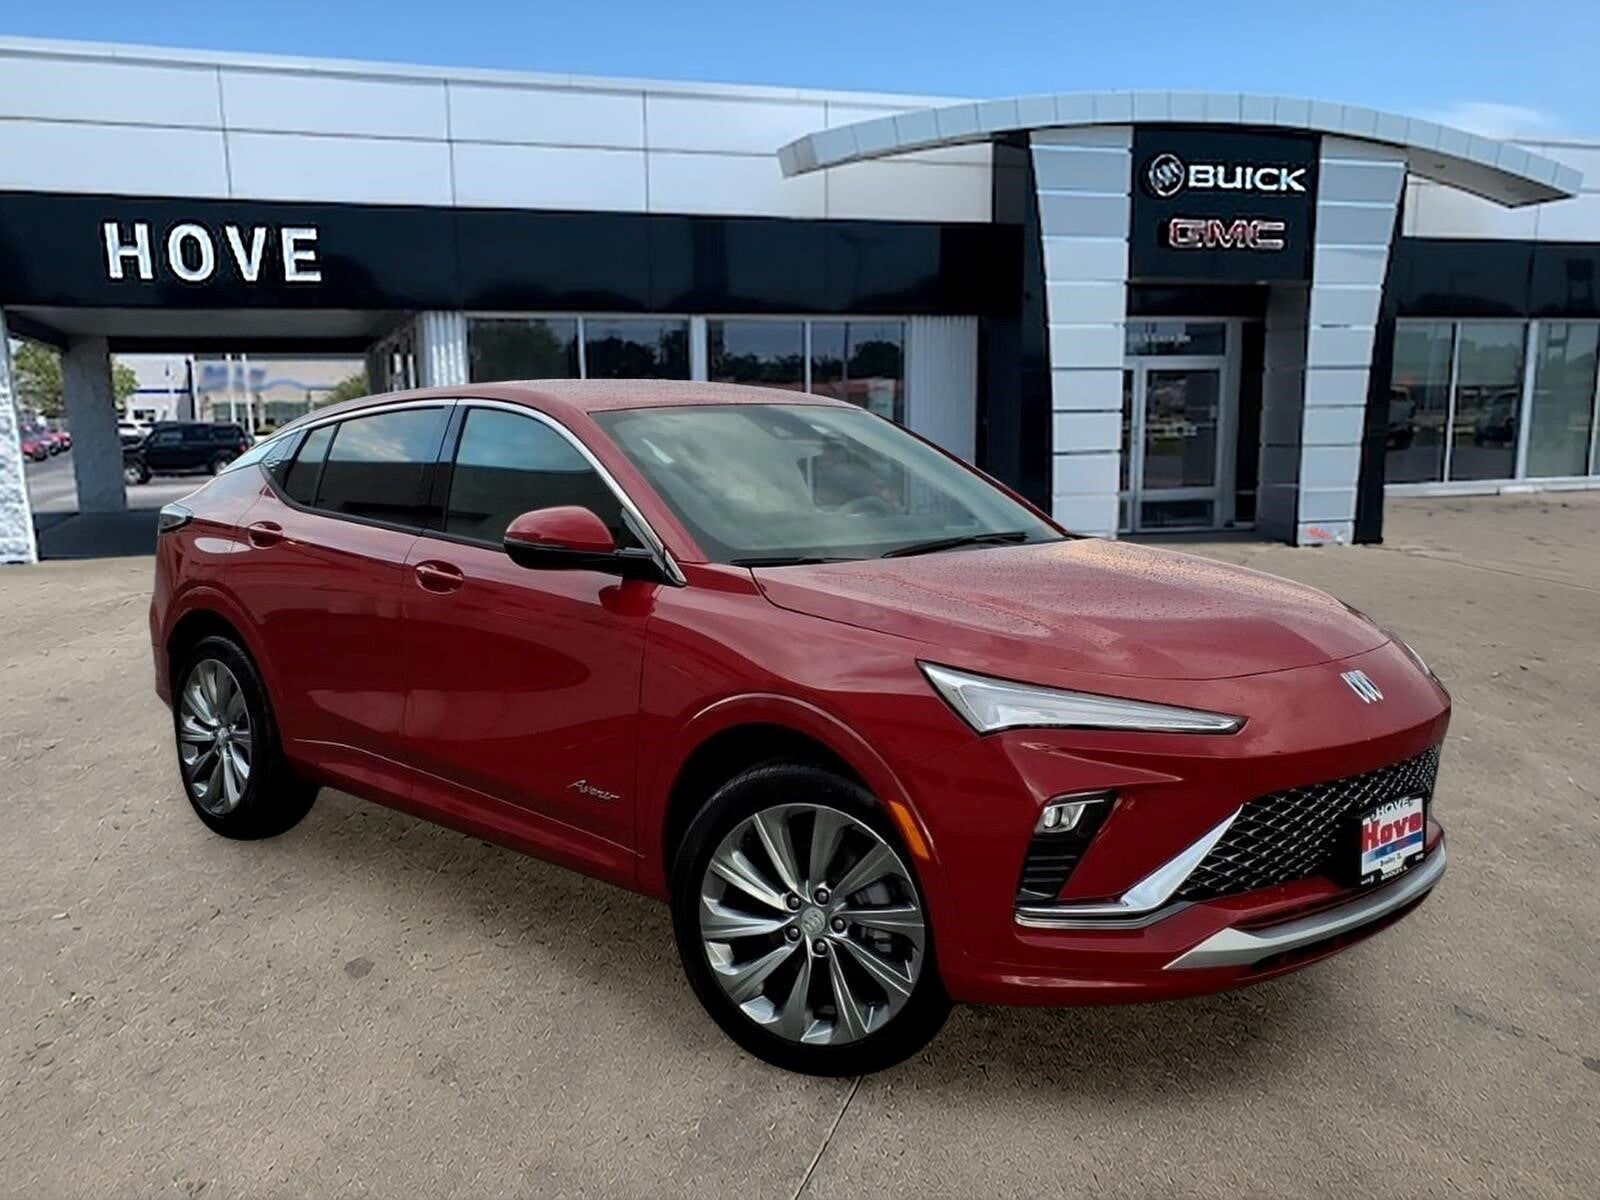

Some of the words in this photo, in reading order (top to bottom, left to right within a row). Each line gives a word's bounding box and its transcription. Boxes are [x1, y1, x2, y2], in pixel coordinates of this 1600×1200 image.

[1188, 165, 1306, 192] BUICK
[1169, 218, 1285, 249] GMC
[103, 222, 322, 282] HOVE
[1375, 796, 1410, 817] HOVE
[1362, 812, 1422, 852] Hove
